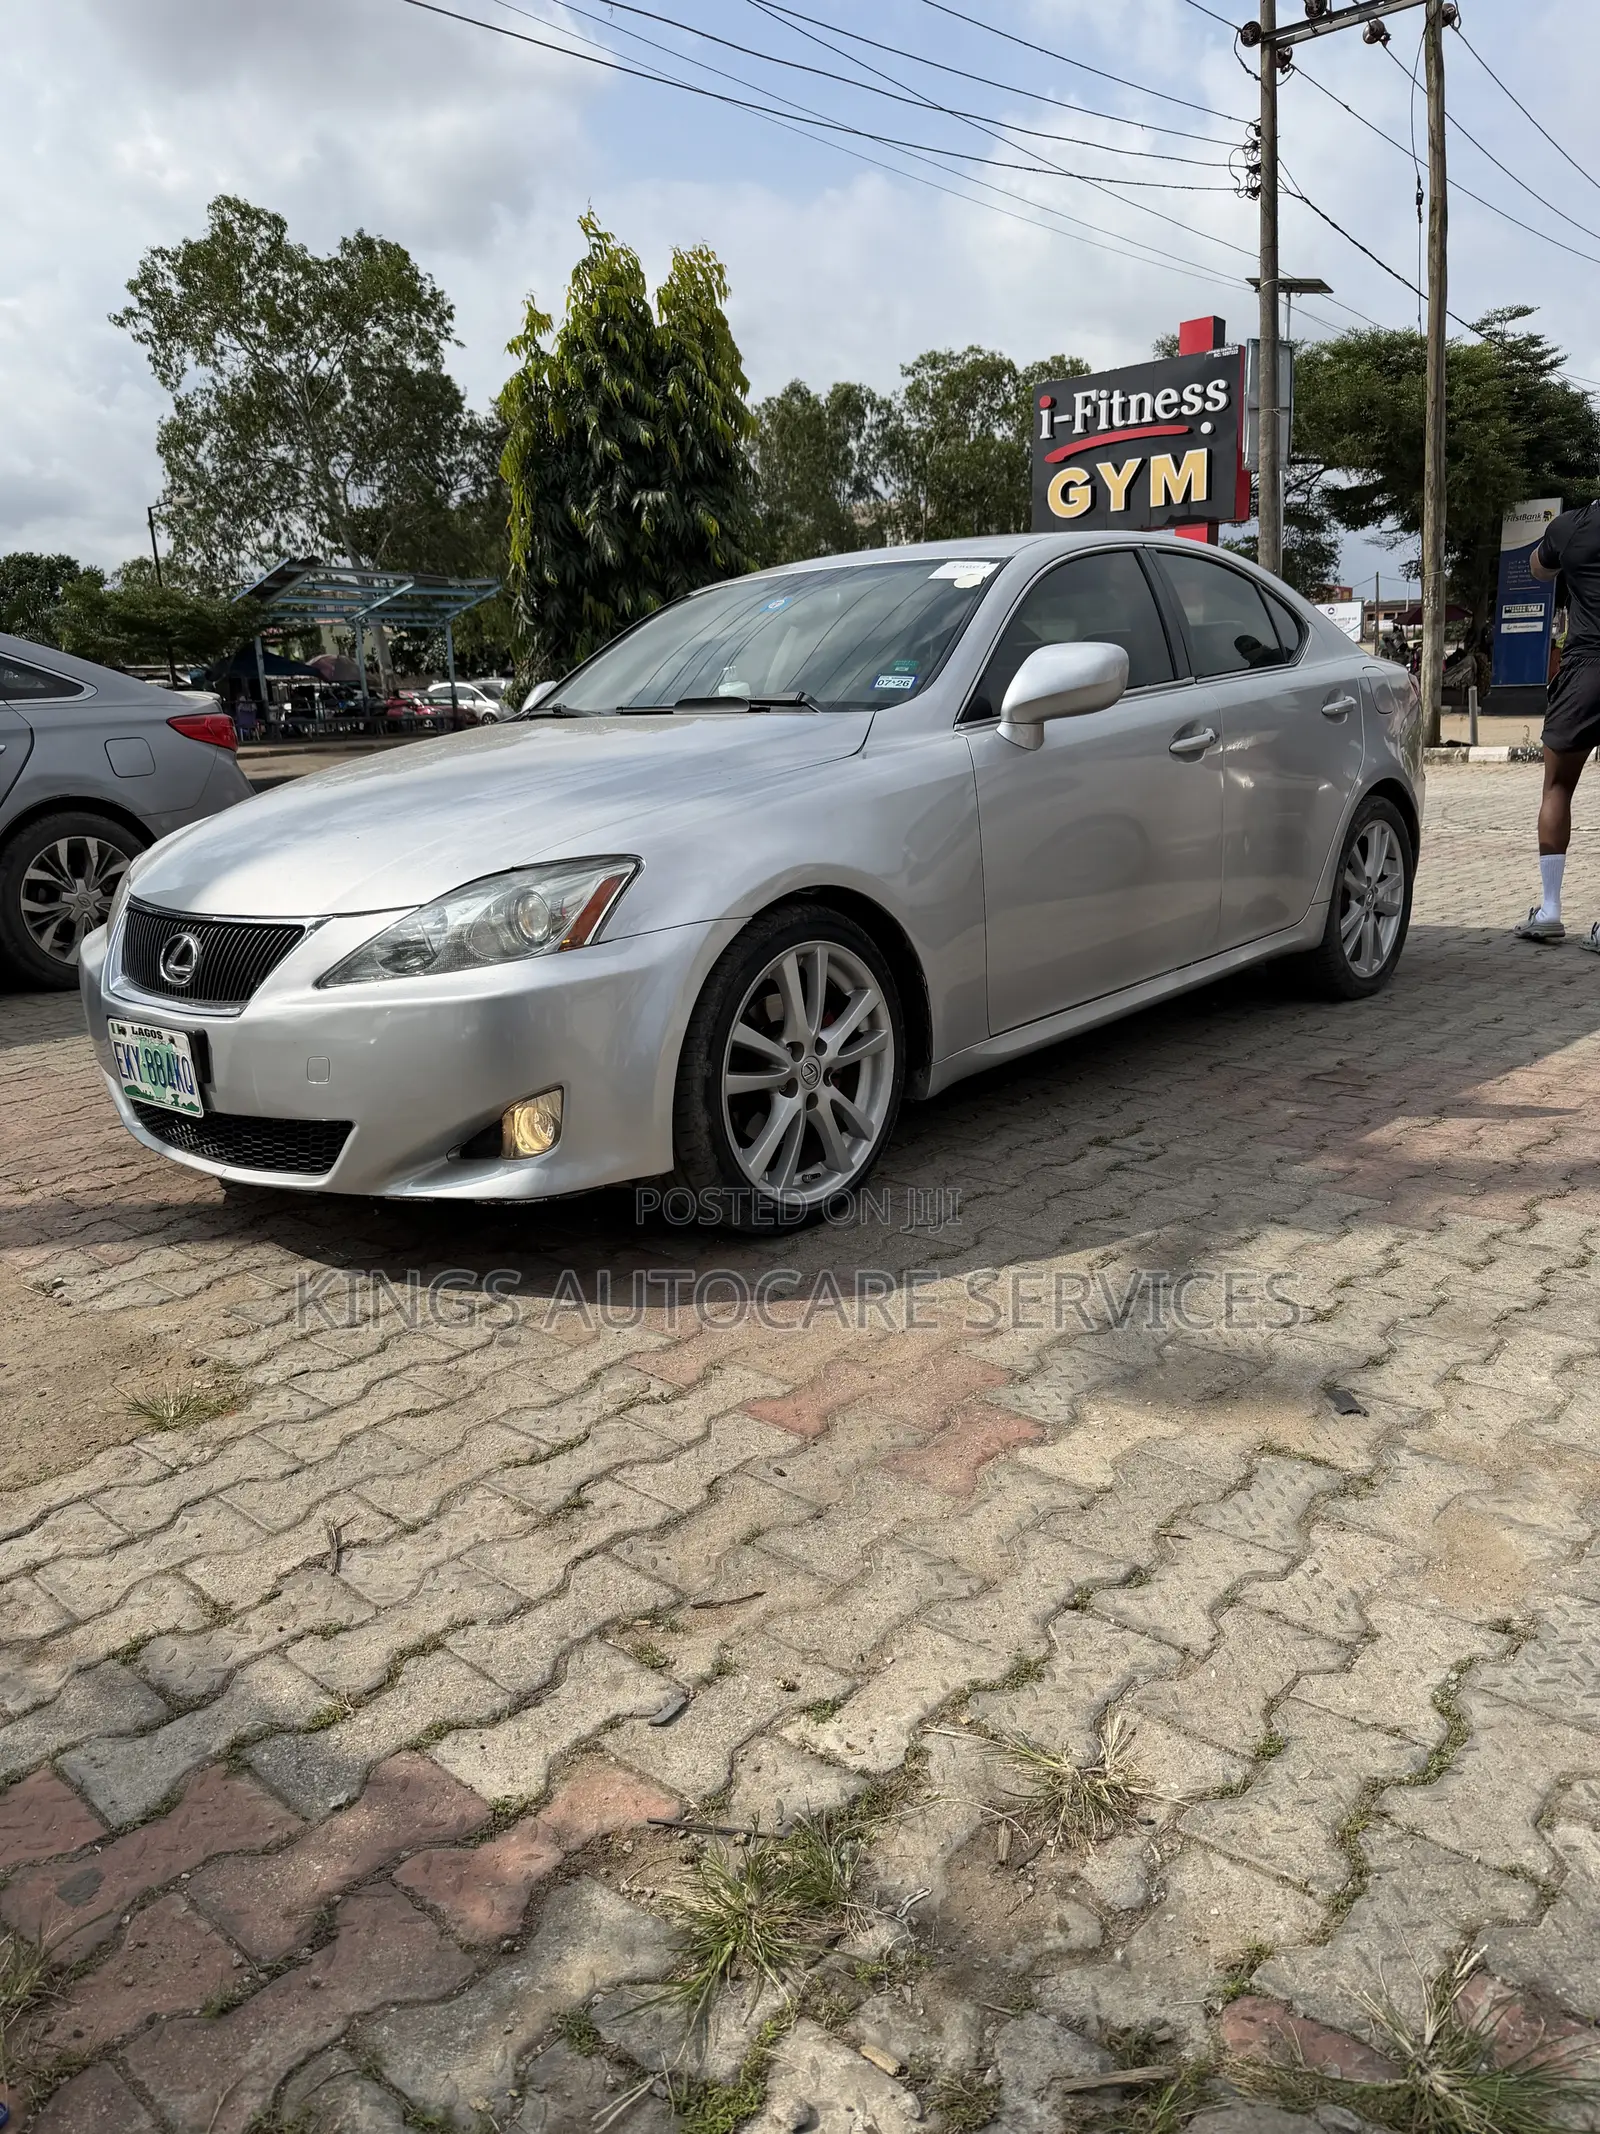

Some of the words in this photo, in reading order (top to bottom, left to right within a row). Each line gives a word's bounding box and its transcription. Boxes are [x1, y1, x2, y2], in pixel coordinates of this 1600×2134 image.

[1039, 378, 1229, 440] i-Fitness
[1047, 447, 1210, 519] GYM
[1506, 513, 1542, 523] FirstBank
[131, 1026, 163, 1040] LAGOS
